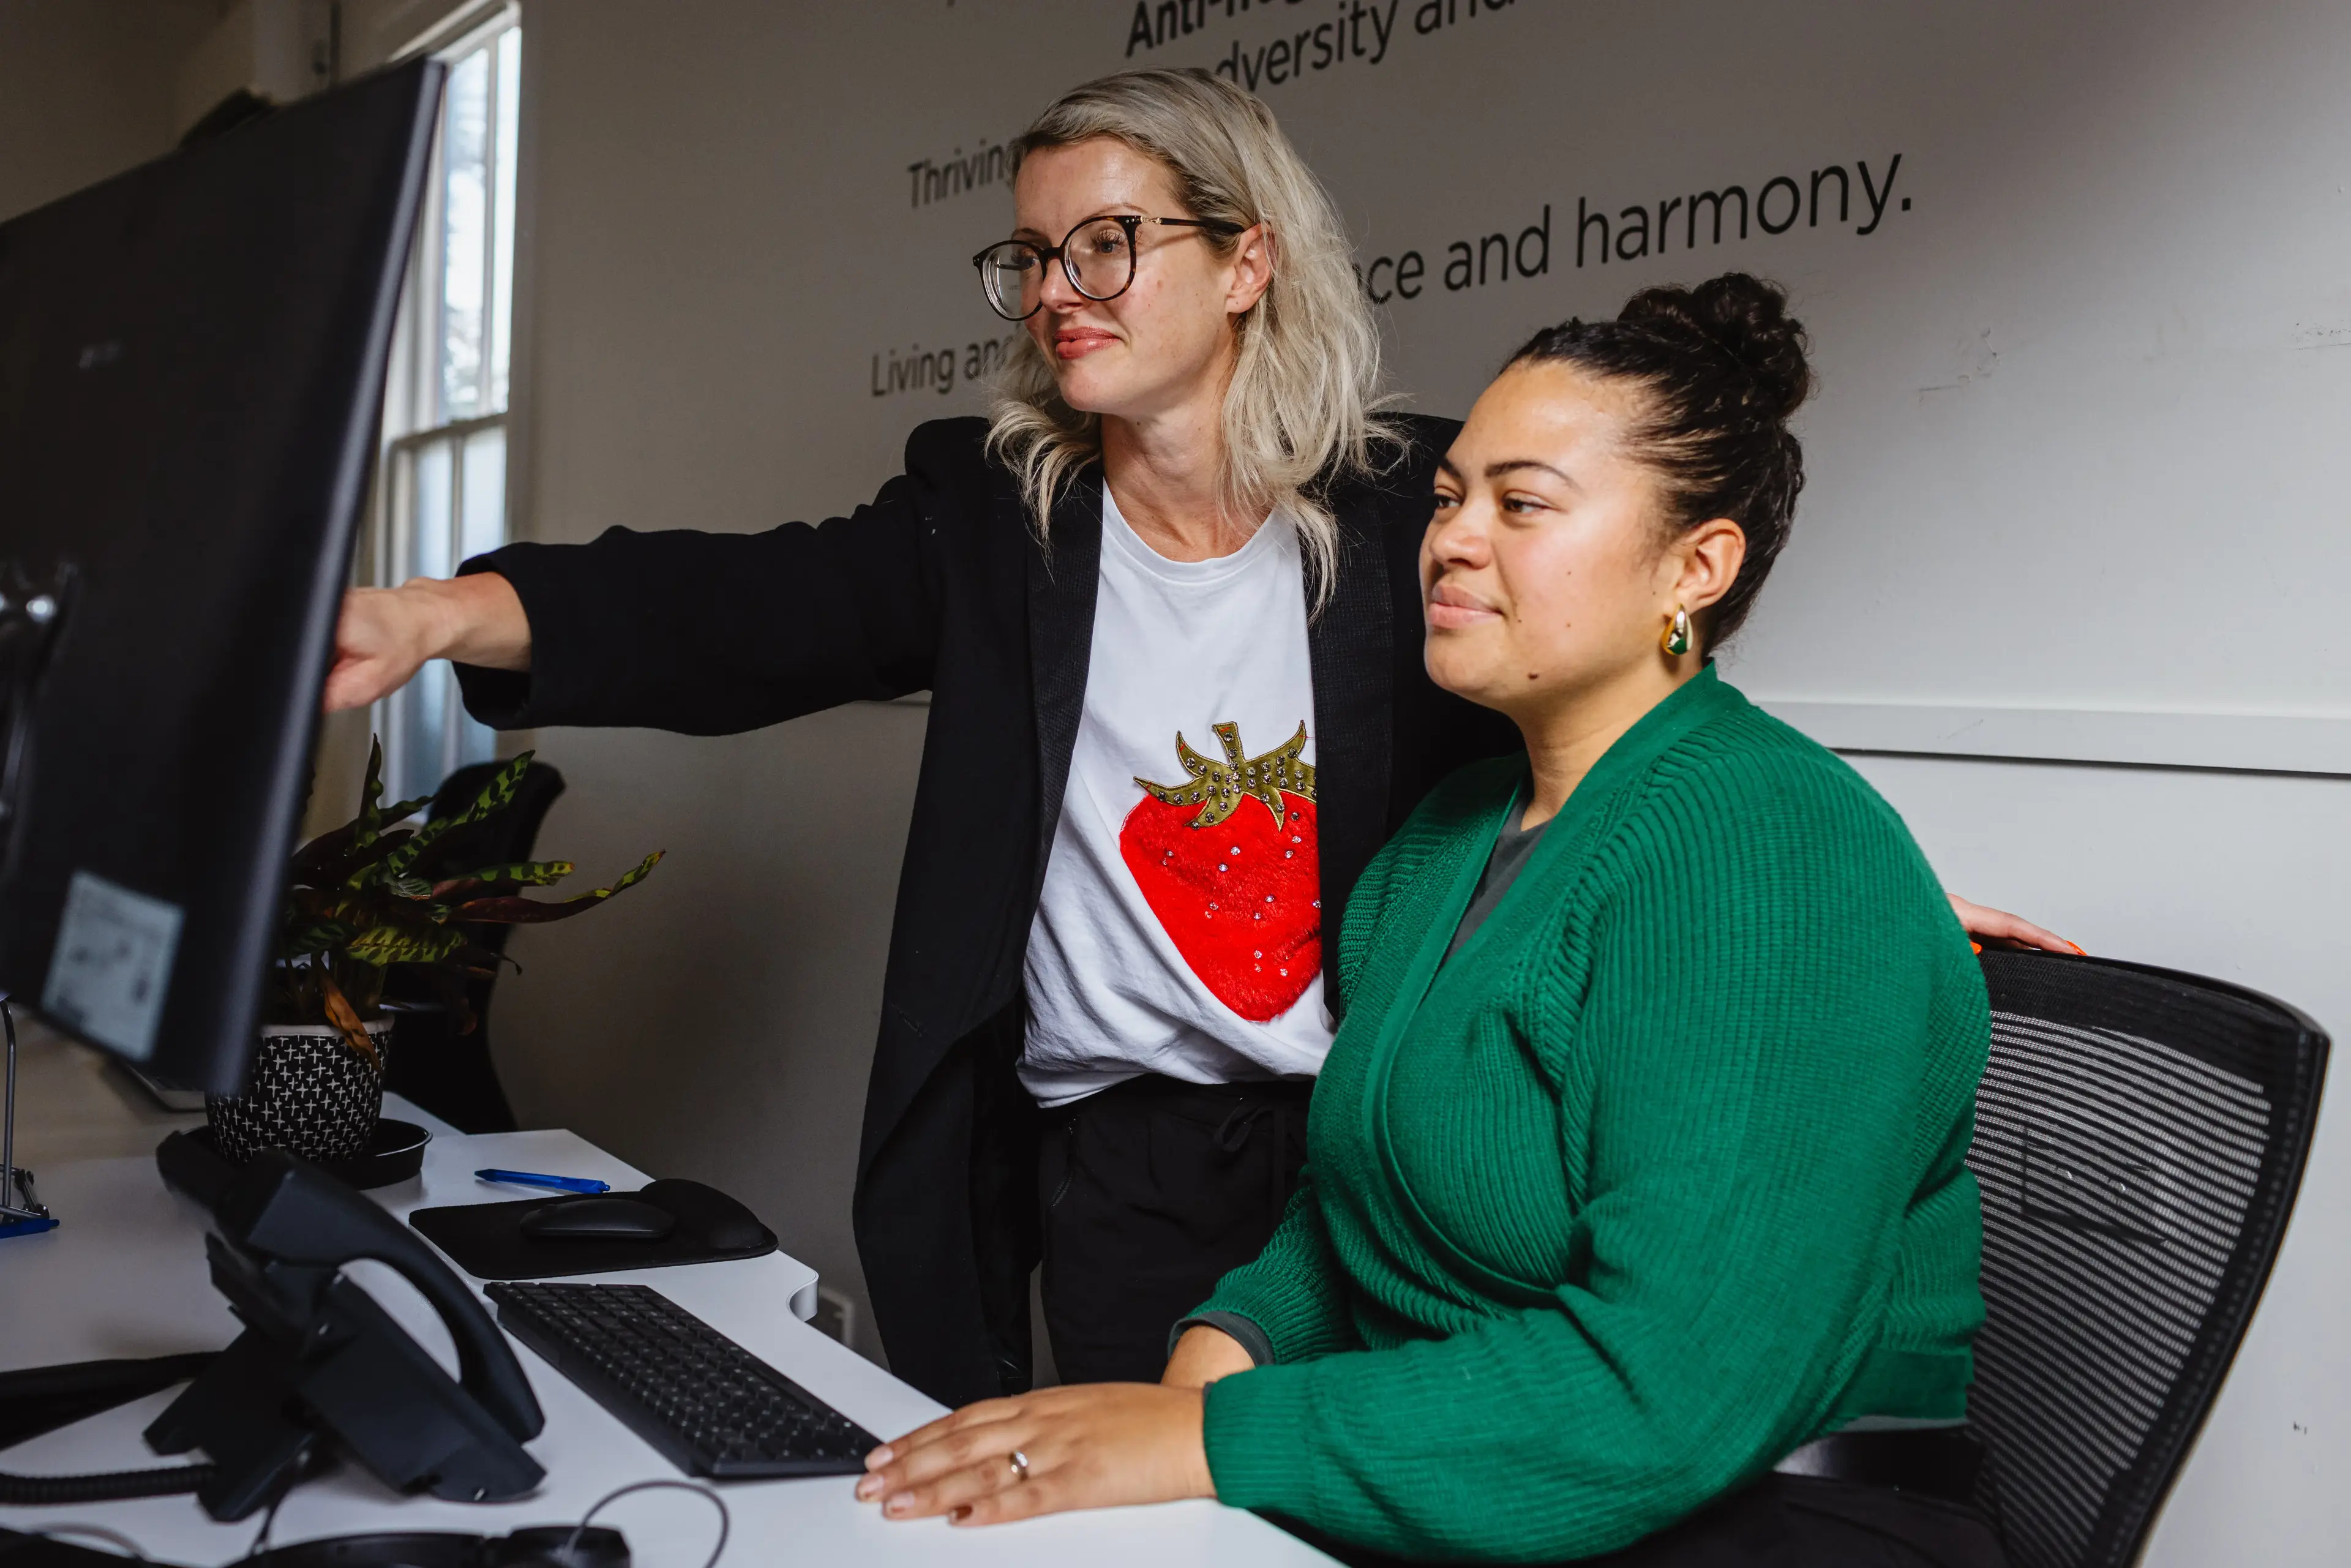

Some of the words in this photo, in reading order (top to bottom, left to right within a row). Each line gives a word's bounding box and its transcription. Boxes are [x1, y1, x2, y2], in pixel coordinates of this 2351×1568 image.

[908, 137, 1005, 208] Thrivin
[1215, 0, 1397, 91] dversity
[871, 342, 954, 397] Living
[964, 323, 1019, 380] an
[1444, 203, 1551, 293] and
[1576, 153, 1911, 268] harmony.
